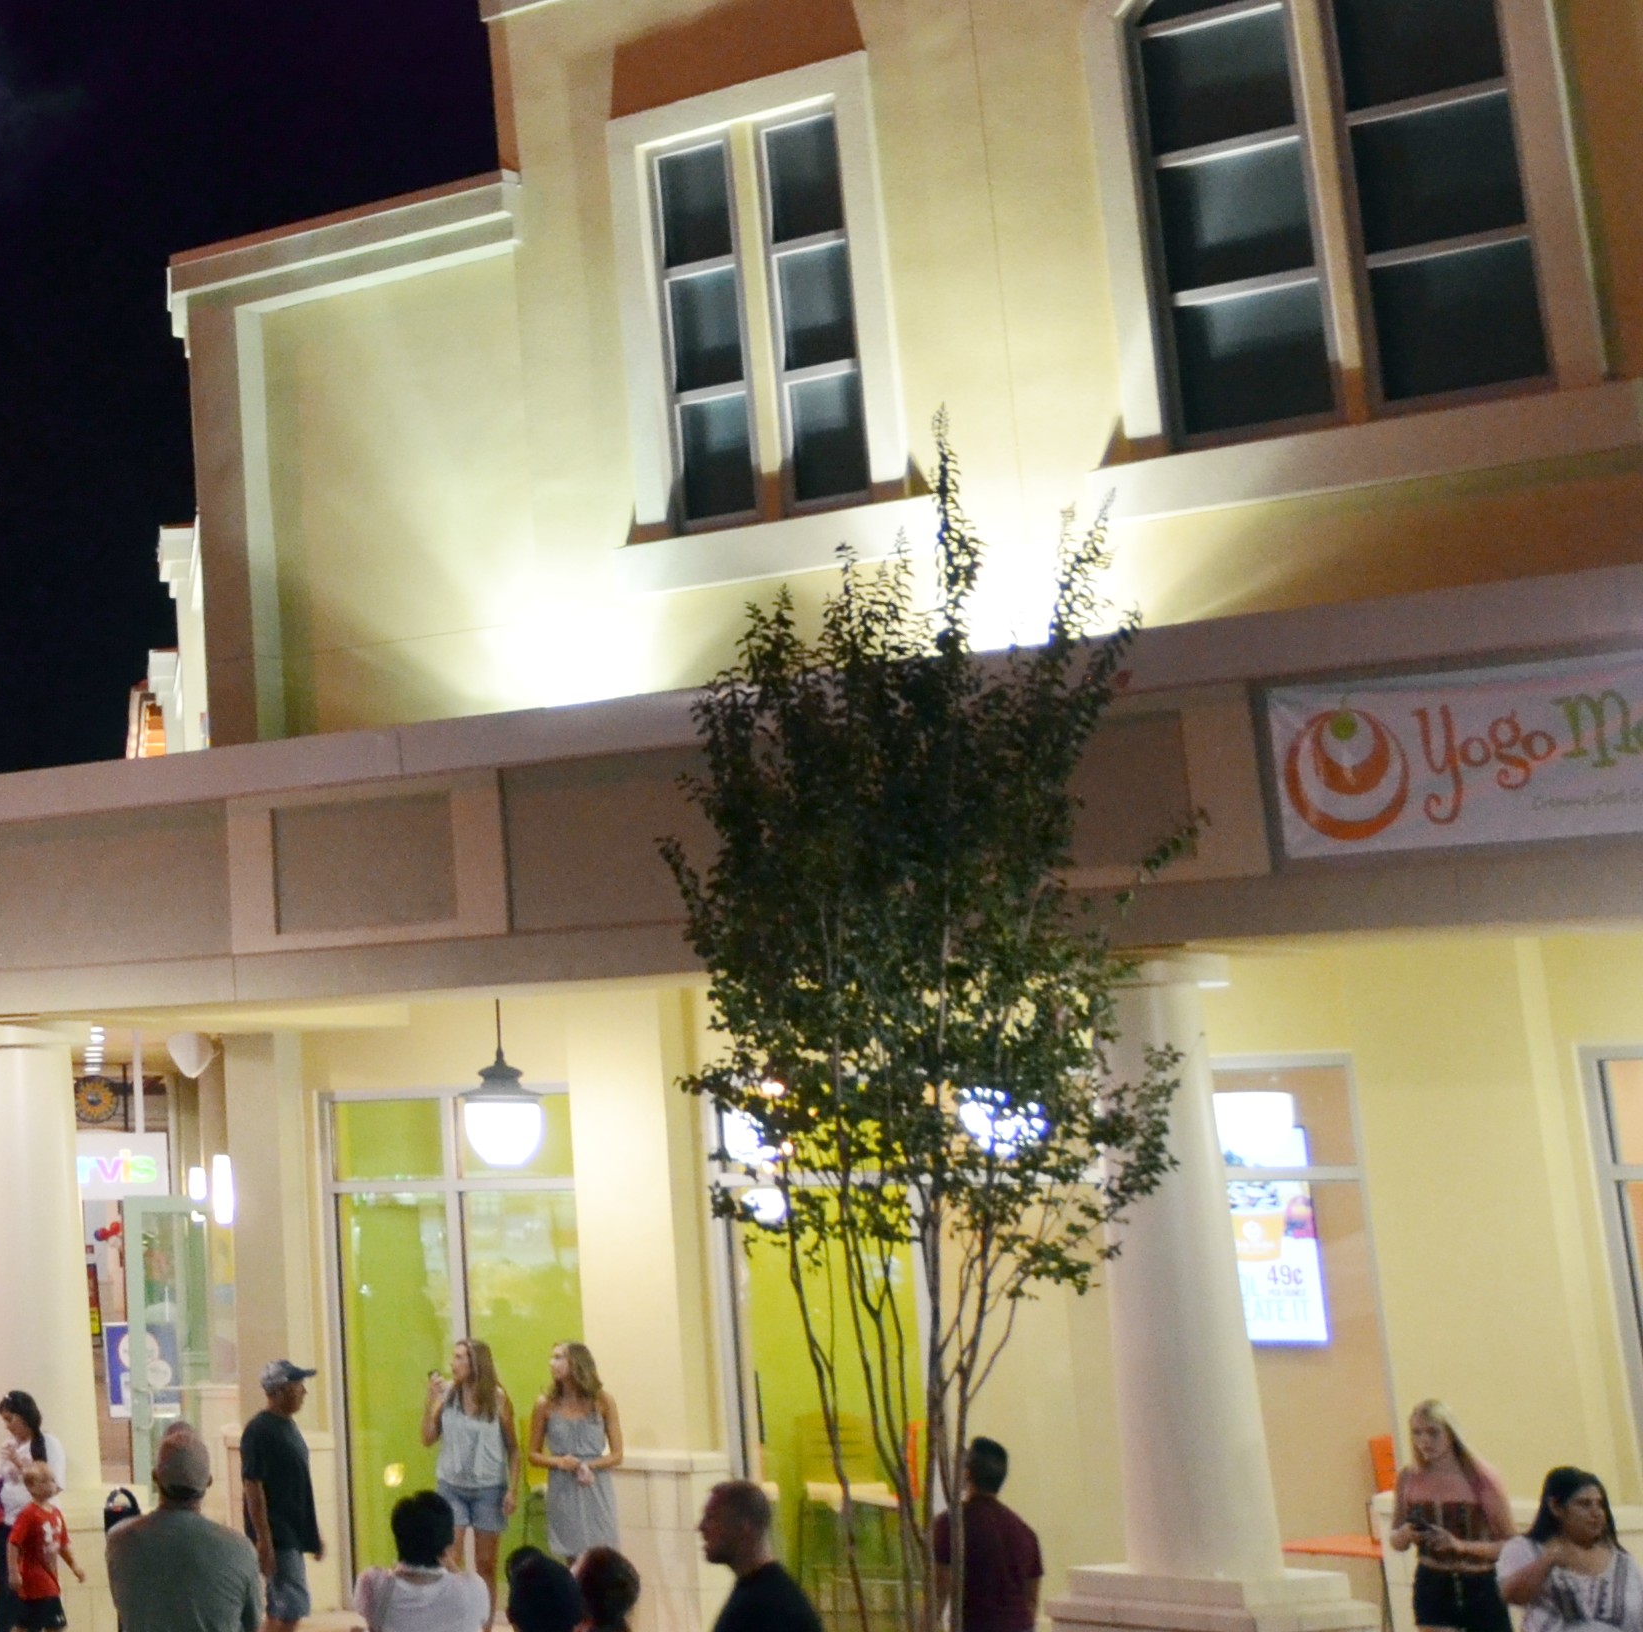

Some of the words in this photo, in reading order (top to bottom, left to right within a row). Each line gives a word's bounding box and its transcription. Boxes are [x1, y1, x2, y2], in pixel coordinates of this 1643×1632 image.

[1412, 704, 1557, 825] Yogo
[1550, 689, 1643, 768] M
[1266, 1264, 1304, 1286] 49¢
